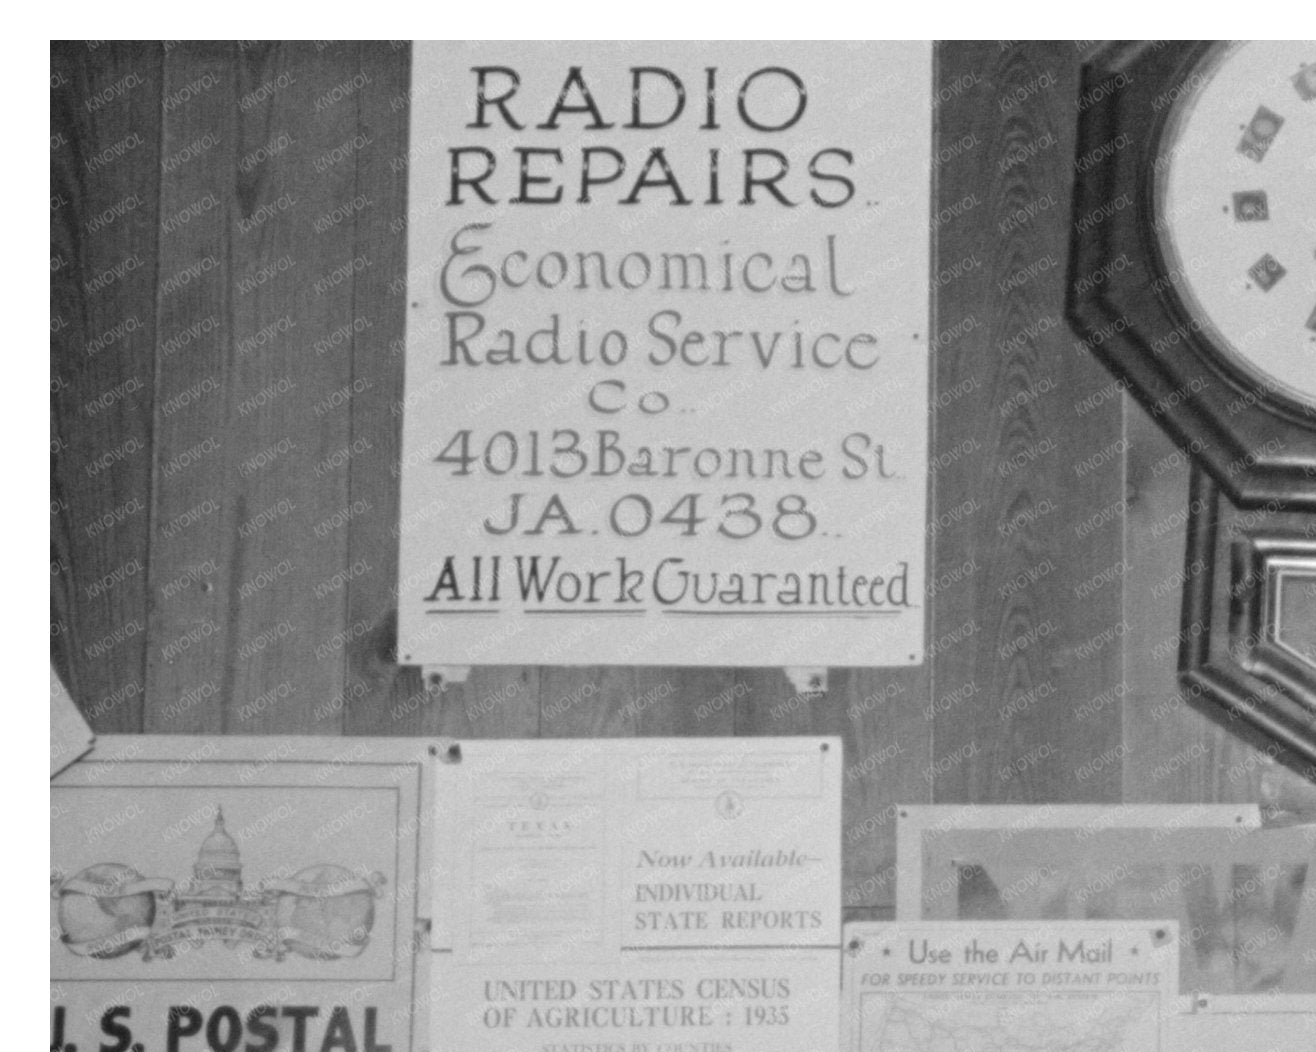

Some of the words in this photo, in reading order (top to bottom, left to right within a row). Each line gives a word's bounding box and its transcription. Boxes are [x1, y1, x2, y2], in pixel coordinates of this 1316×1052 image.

[465, 65, 808, 132] RADIO
[439, 222, 855, 308] Economical
[441, 310, 627, 367] Radio
[648, 309, 880, 371] Service
[424, 555, 500, 602] All
[515, 555, 646, 604] Work
[636, 850, 692, 869] Now
[634, 883, 762, 902] INDIVIDUAL
[634, 911, 709, 930] STATE
[722, 910, 822, 929] REPORTS
[909, 939, 951, 964] Use
[964, 940, 999, 963] the
[1009, 941, 1049, 963] Air
[1057, 938, 1112, 963] Mail
[484, 979, 577, 1001] UNITED
[589, 979, 684, 1000] STATES
[696, 978, 790, 999] CENSUS
[860, 973, 891, 986] FOR
[897, 973, 946, 986] SPEEDY
[951, 973, 1008, 986] SERVICE
[1017, 972, 1036, 985] TO
[1041, 972, 1102, 985] DISTANT
[1107, 972, 1160, 985] POINTS
[483, 1006, 517, 1029] OF
[527, 1006, 713, 1028] AGRICULTURE
[745, 1005, 789, 1026] 1935
